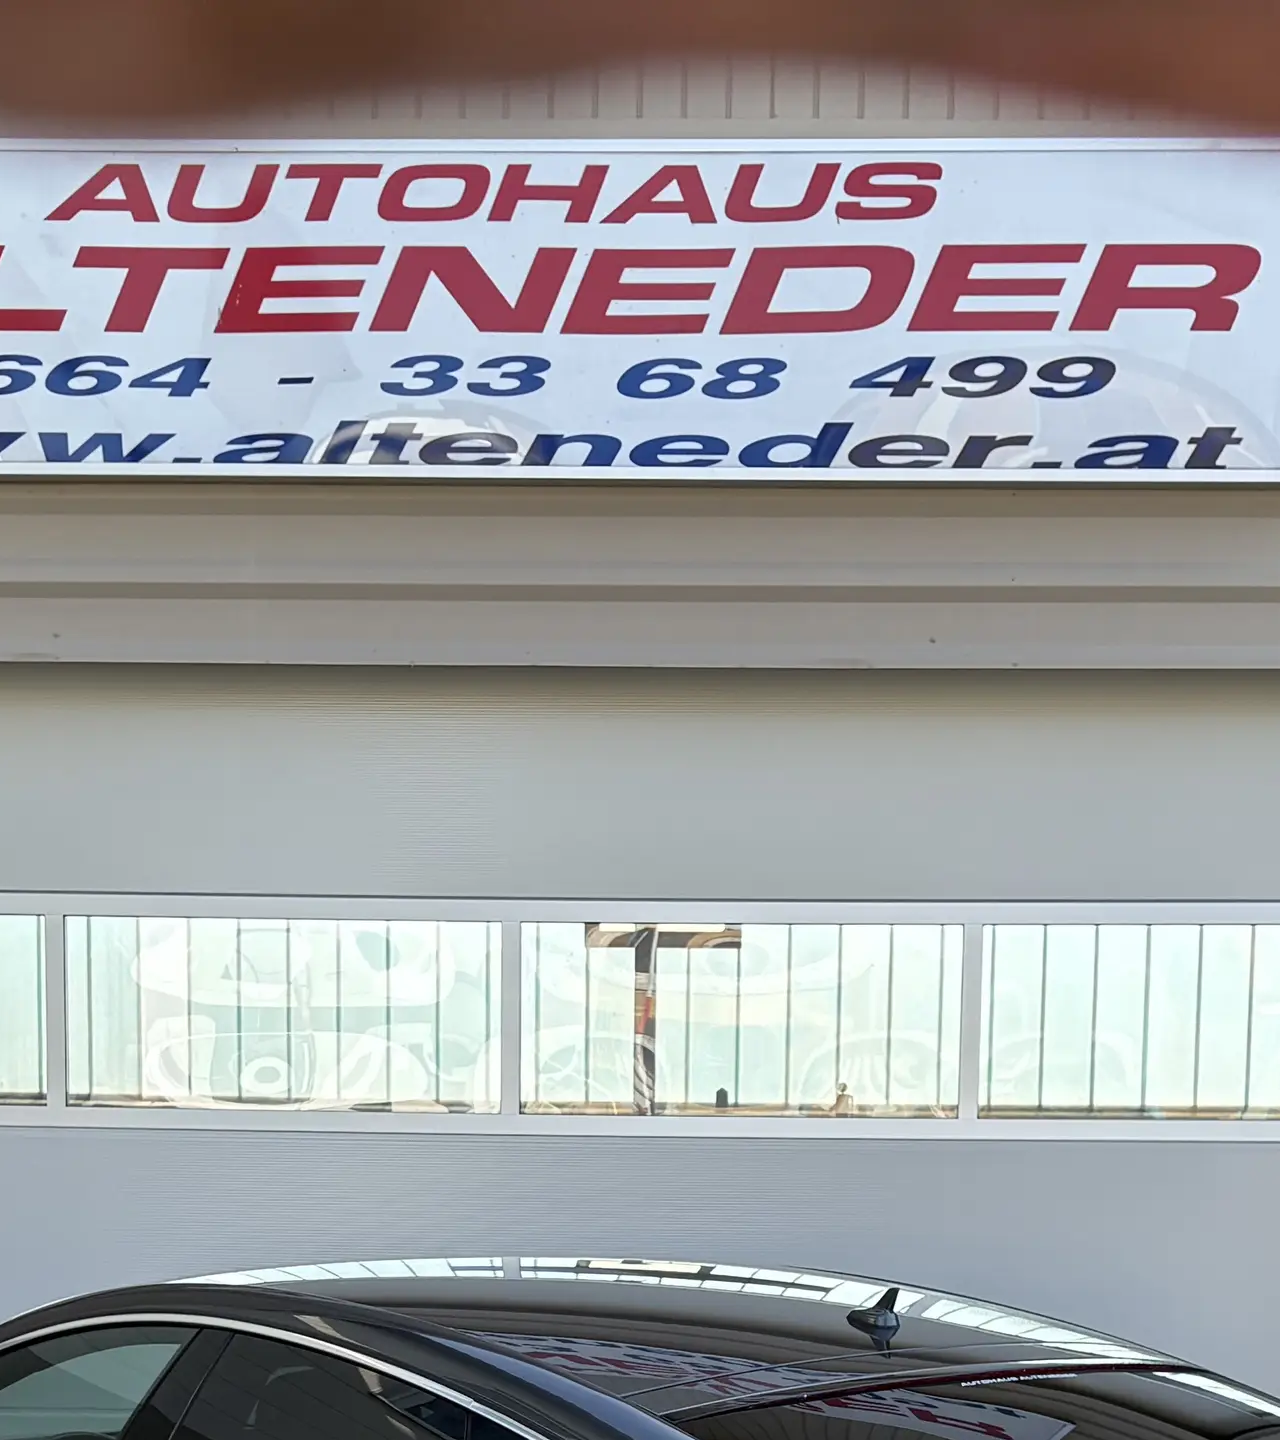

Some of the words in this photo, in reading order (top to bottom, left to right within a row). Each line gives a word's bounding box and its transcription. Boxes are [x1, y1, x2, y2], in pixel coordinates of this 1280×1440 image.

[46, 162, 942, 224] AUTOHAUS
[278, 376, 314, 385] -
[380, 354, 551, 397] 33
[616, 357, 787, 400] 68
[848, 355, 1117, 399] 499
